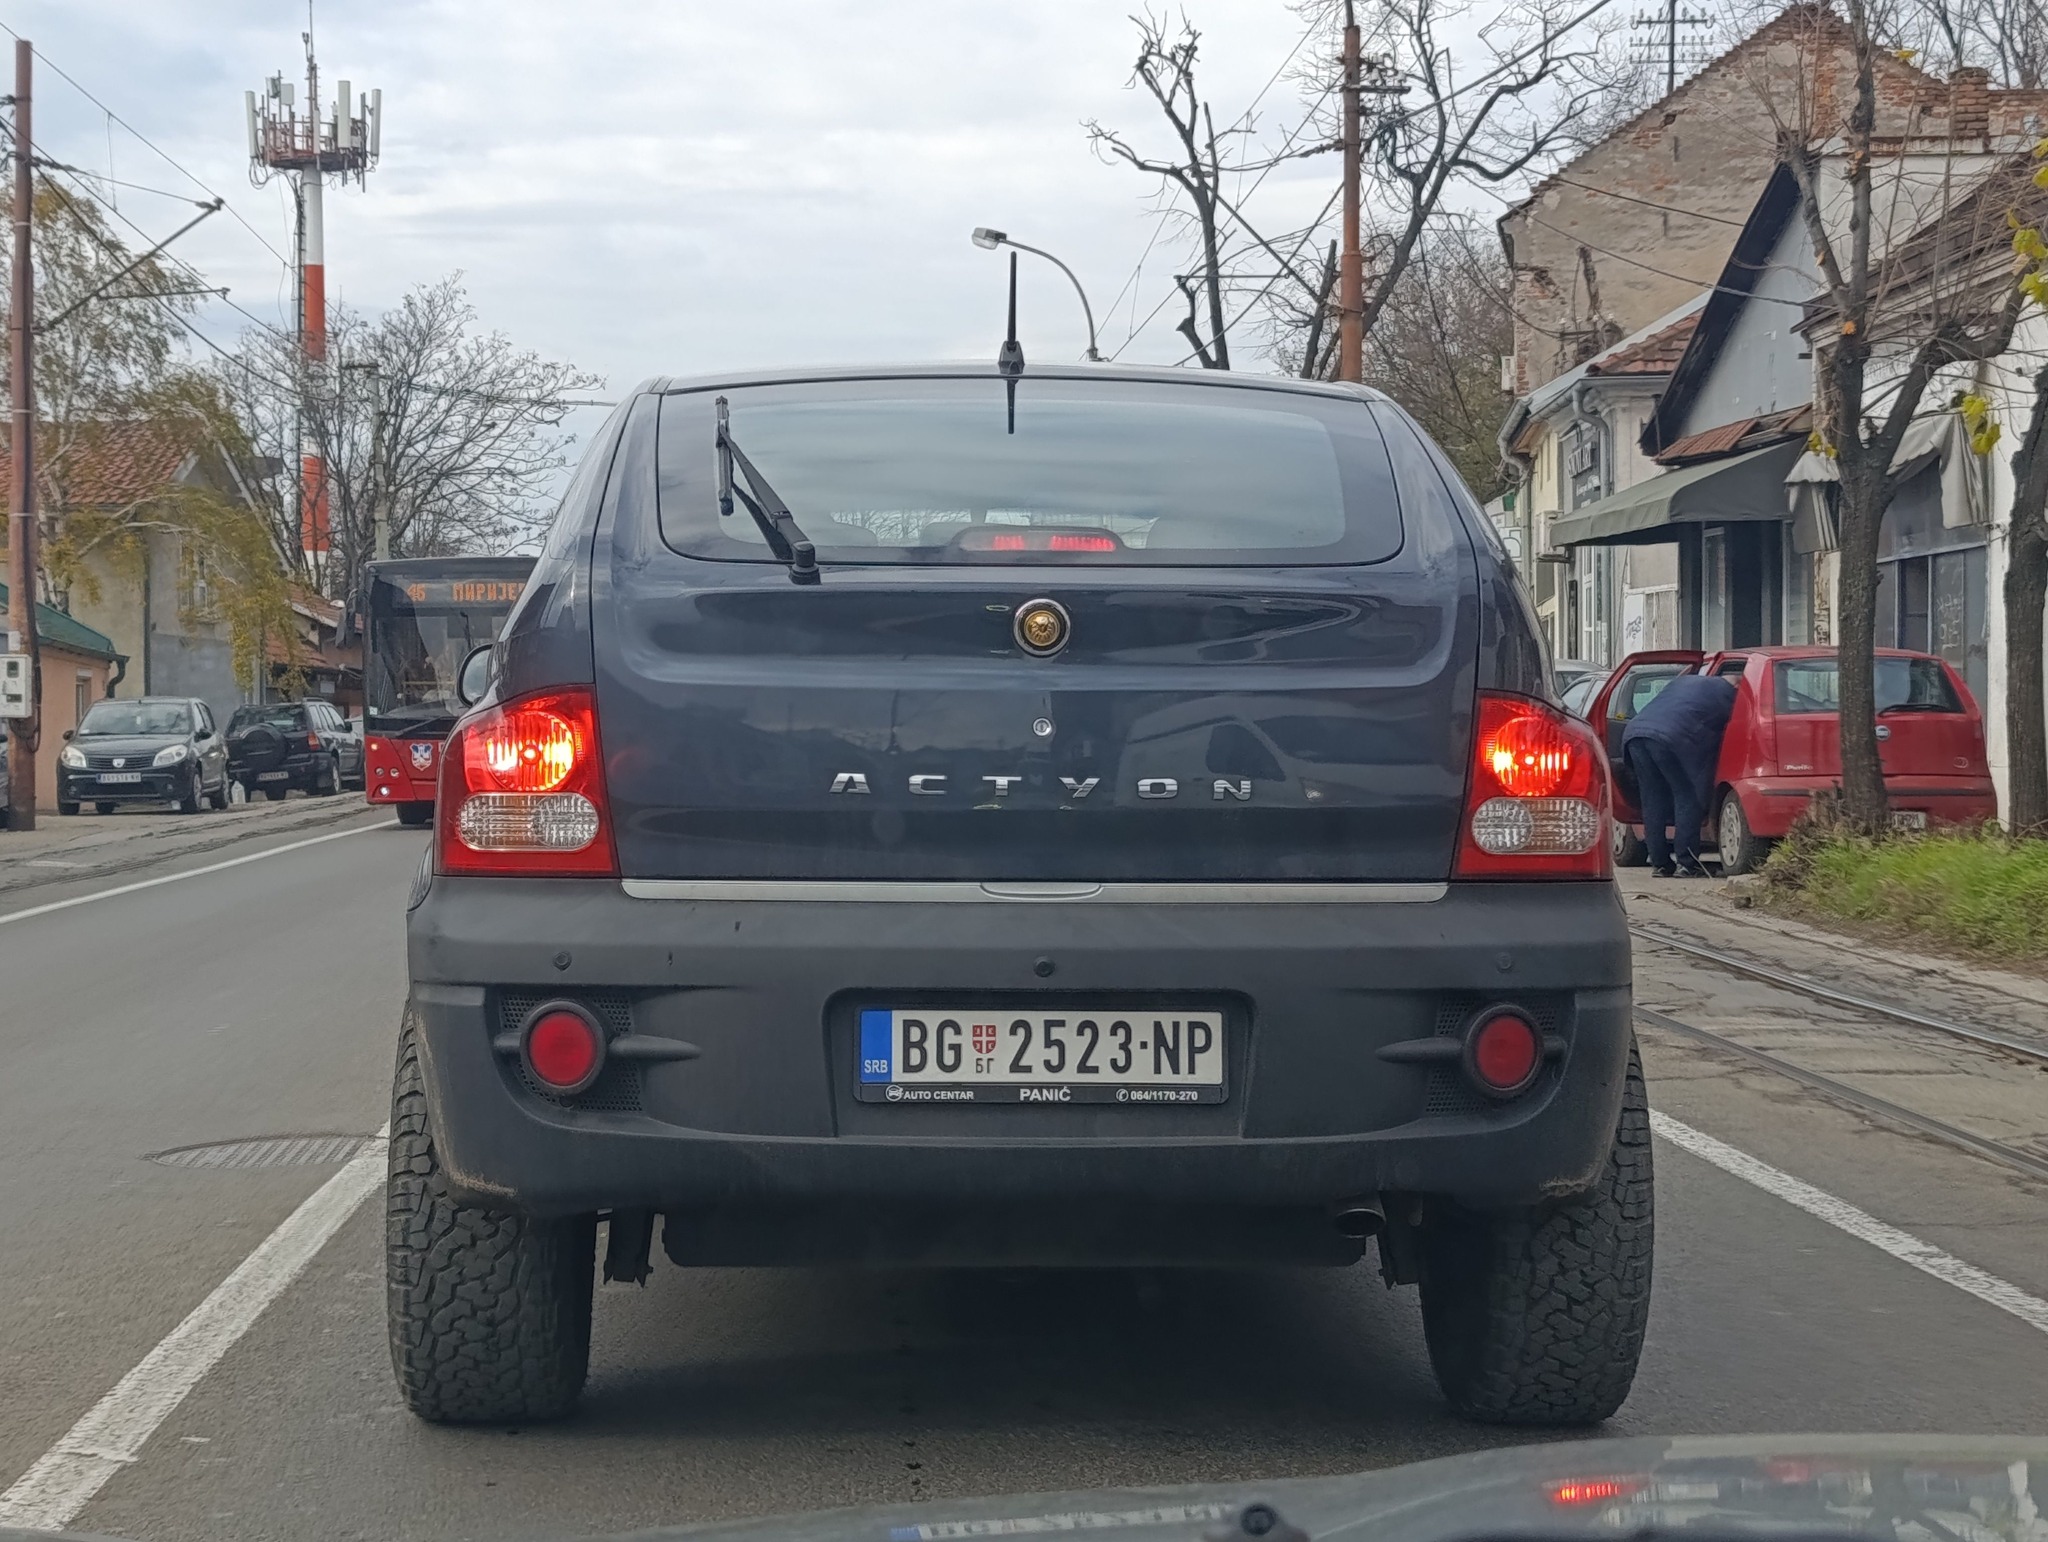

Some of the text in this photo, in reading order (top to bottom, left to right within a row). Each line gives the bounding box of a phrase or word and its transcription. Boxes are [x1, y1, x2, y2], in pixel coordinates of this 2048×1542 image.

[829, 772, 1252, 801] ACTYON
[902, 1019, 962, 1074] BG
[864, 1060, 888, 1074] SRB
[904, 1090, 975, 1100] AUTO CENTAR
[1020, 1086, 1072, 1101] PANIĆ
[1130, 1090, 1198, 1101] 064/1170-270
